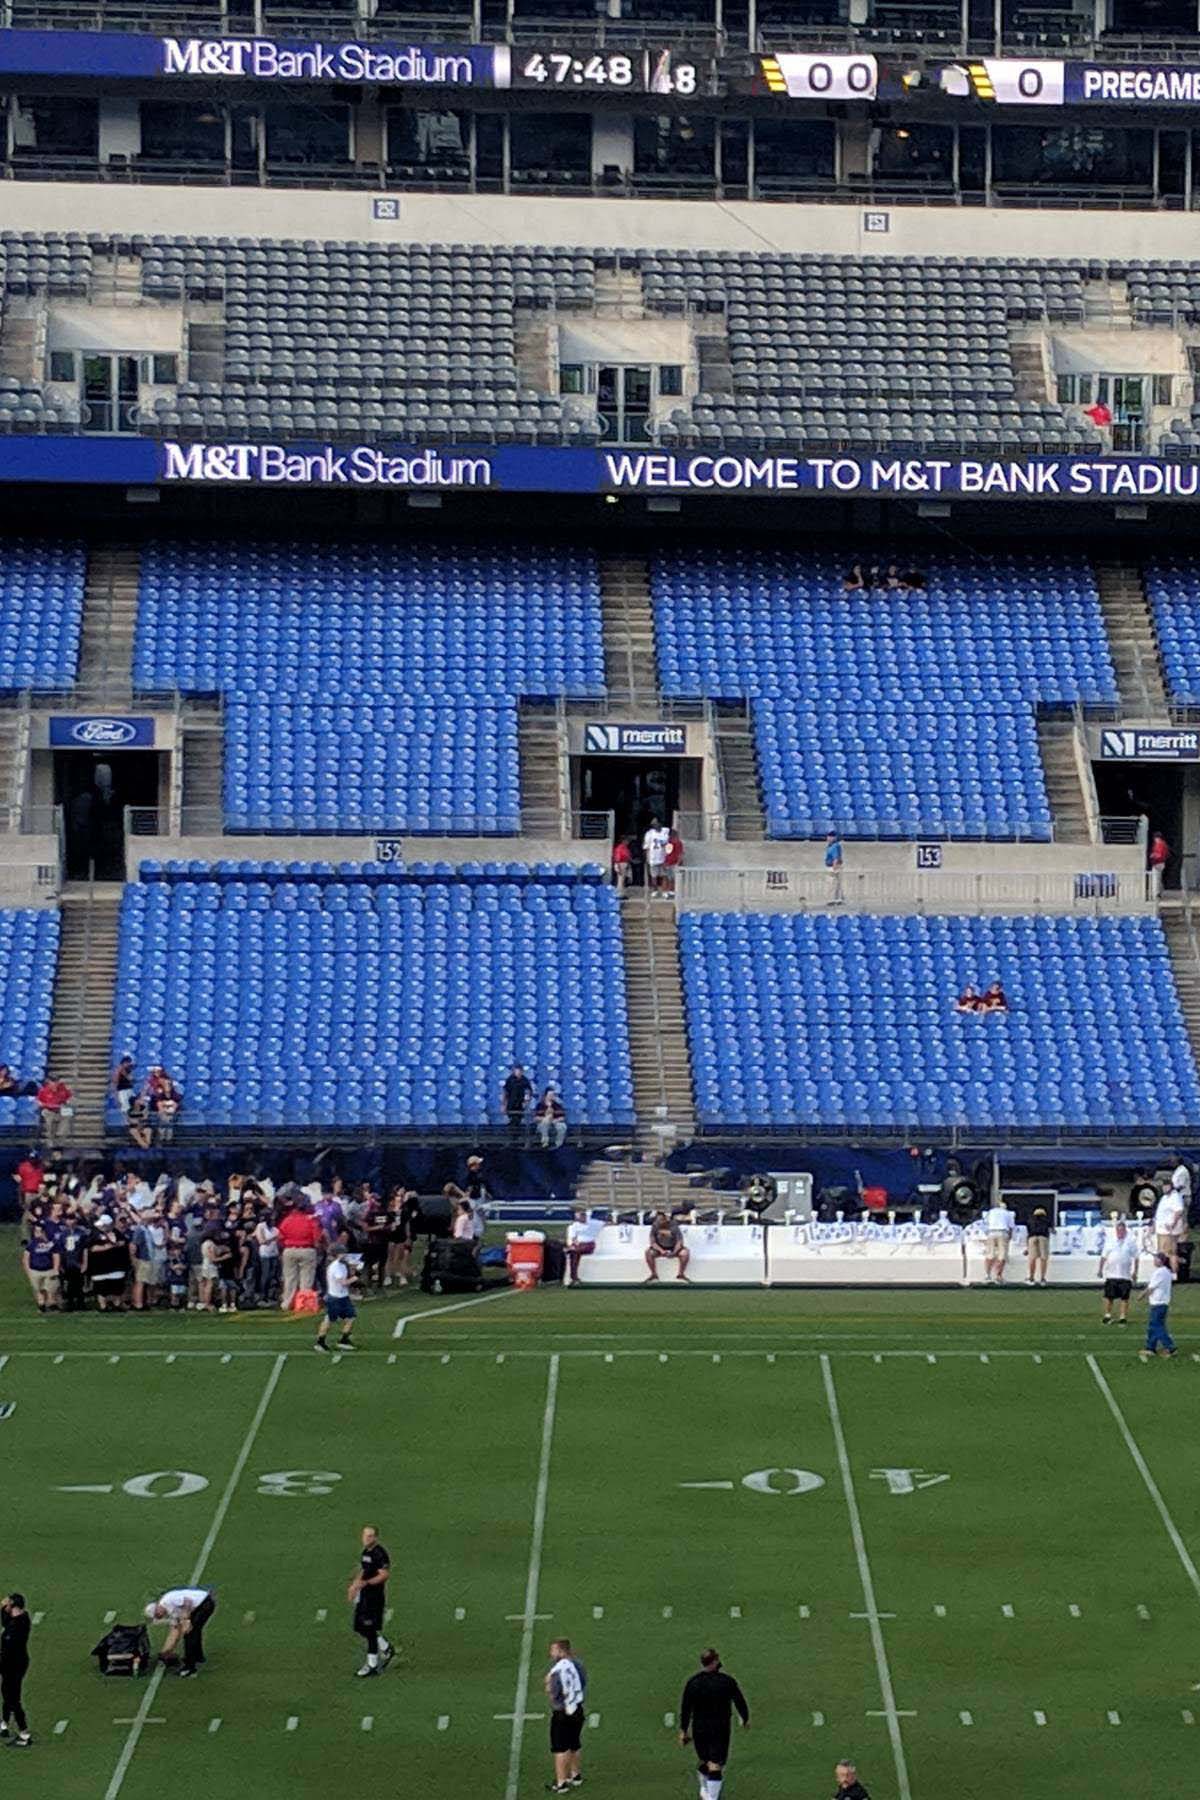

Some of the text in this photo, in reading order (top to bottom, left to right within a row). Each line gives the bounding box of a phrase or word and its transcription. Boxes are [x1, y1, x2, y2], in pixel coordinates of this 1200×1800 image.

[163, 39, 473, 83] M&T Bank Stadium
[523, 54, 632, 86] 47:48
[1018, 69, 1044, 97] 0
[163, 442, 491, 485] M&T Bank Stadium
[604, 455, 800, 489] WELCOME
[807, 458, 862, 490] TO
[871, 459, 951, 491] M&T
[960, 461, 1061, 493] BANK
[82, 720, 125, 741] Ford
[622, 727, 685, 744] merritt
